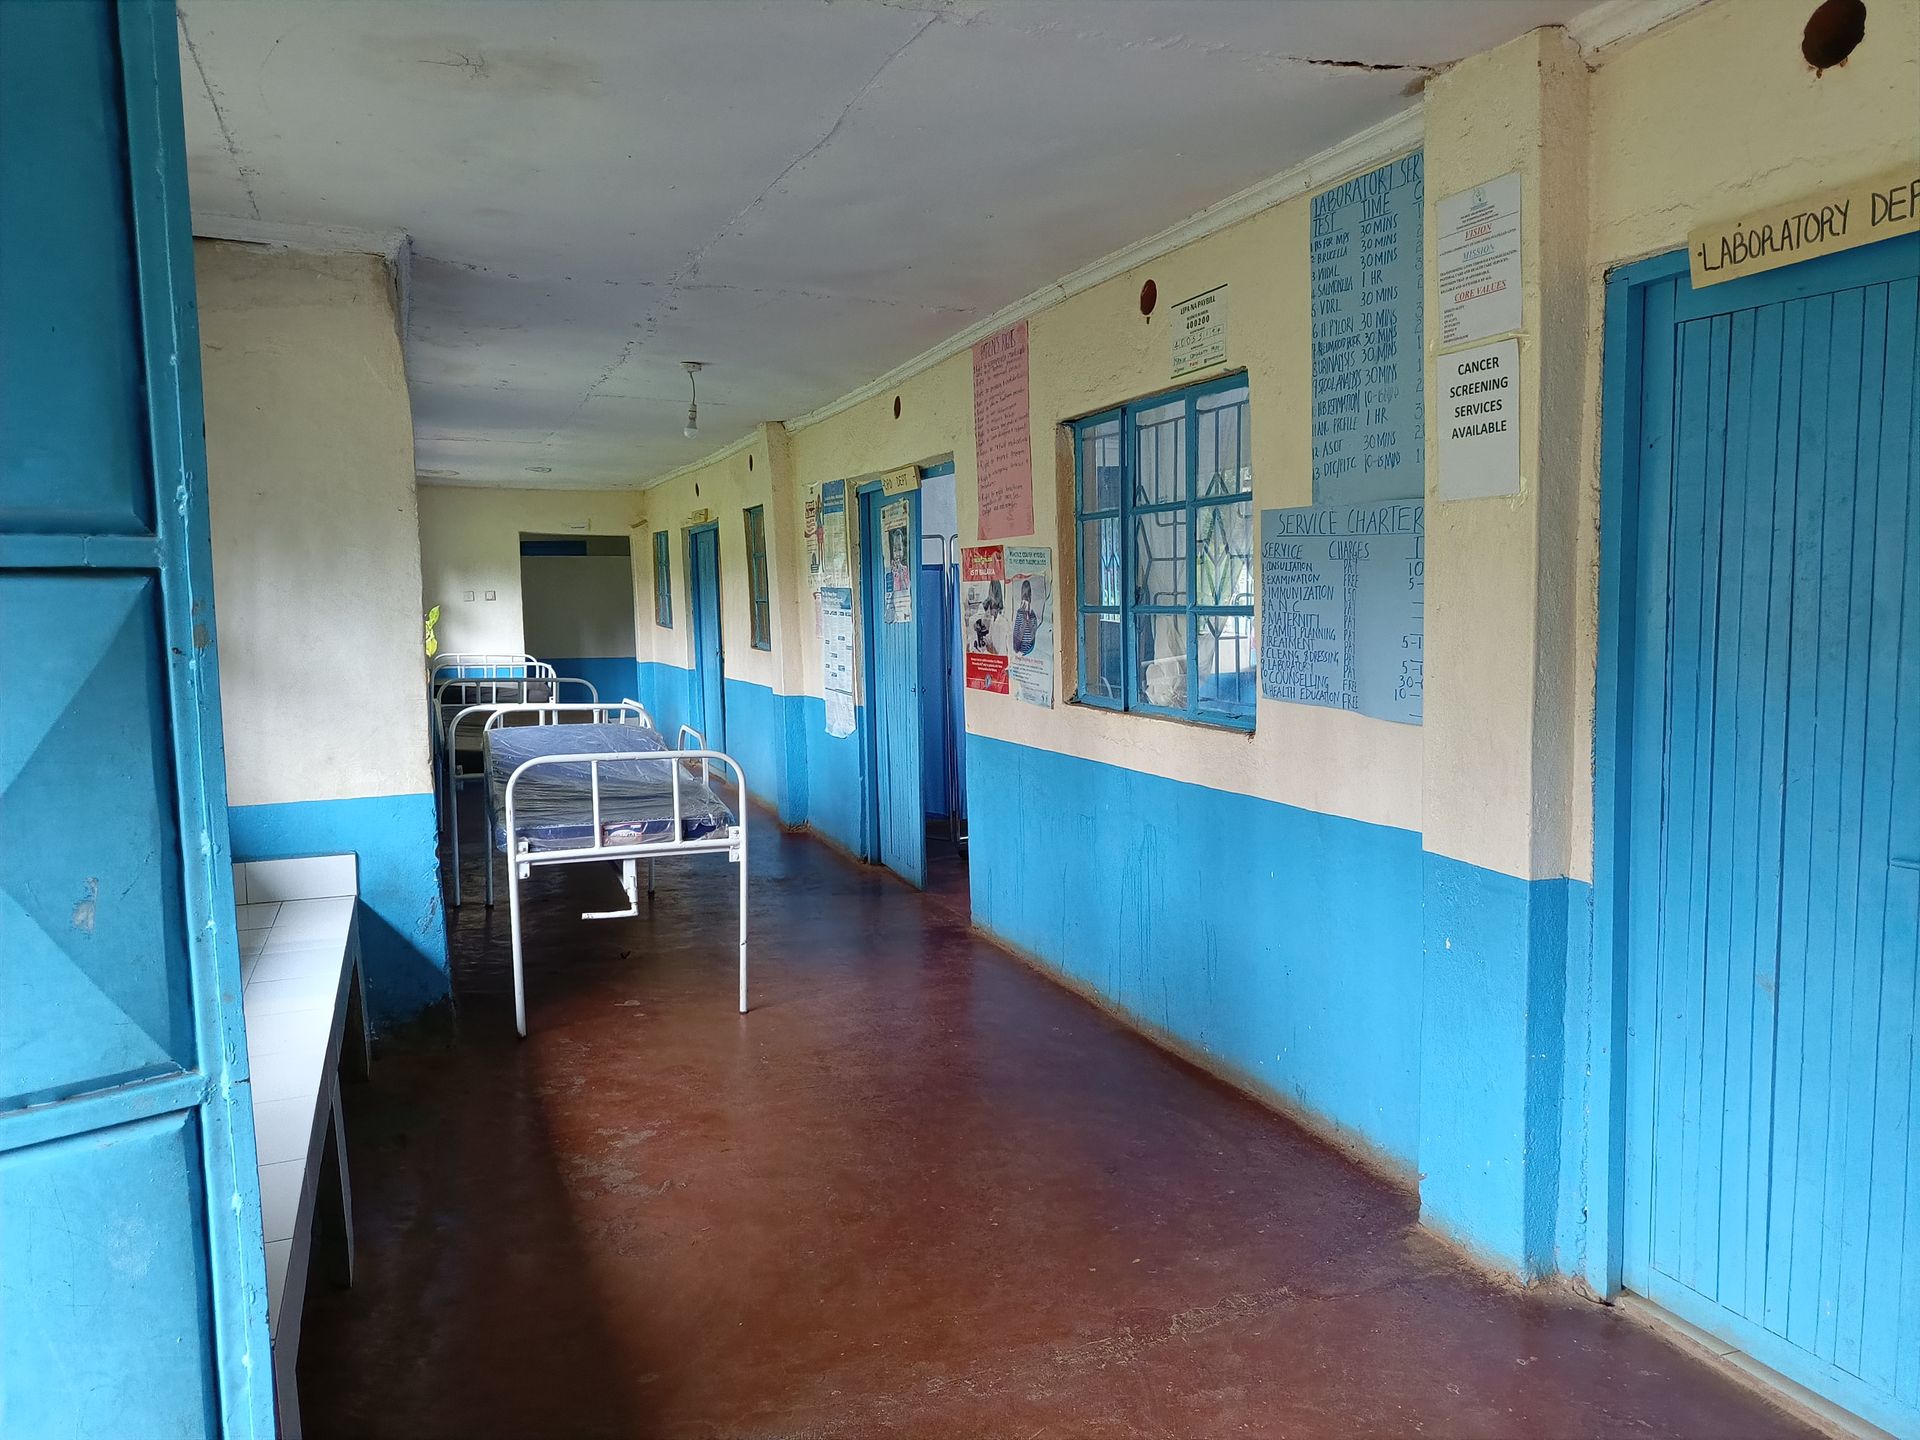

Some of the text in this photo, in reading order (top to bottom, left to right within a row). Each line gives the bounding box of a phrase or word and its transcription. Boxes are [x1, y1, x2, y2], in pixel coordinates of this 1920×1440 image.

[1314, 212, 1336, 237] TEST
[1361, 192, 1390, 220] TIME
[1360, 222, 1371, 238] 30
[1373, 214, 1398, 235] MINS
[1465, 223, 1493, 239] VISION
[1702, 199, 1849, 271] LABORATORY
[1360, 239, 1372, 253] 30
[1375, 233, 1397, 248] MINS
[1463, 243, 1495, 260] MISSION
[1360, 253, 1373, 270] 30
[1375, 247, 1398, 266] MINS
[1371, 269, 1382, 285] HR
[1454, 280, 1506, 301] CORE VALUES
[1320, 298, 1342, 316] VDRL
[1360, 291, 1373, 307] 30
[1376, 286, 1398, 303] MINS
[1329, 317, 1354, 337] PYLORI
[1360, 312, 1372, 330] 30
[1376, 308, 1397, 328] MINS
[1363, 331, 1375, 347] 30
[1377, 325, 1397, 344] MINS
[1362, 347, 1375, 363] 30
[1376, 341, 1397, 361] MINS
[1364, 366, 1377, 386] 30
[1378, 363, 1398, 384] MINS
[1458, 356, 1500, 376] CANCER
[1449, 376, 1508, 399] SCREENING
[1375, 407, 1388, 425] HR
[1454, 399, 1503, 418] SERVICES
[1451, 420, 1507, 440] AVAILABLE
[1363, 434, 1375, 451] 30
[1278, 505, 1424, 535] SERVICE CHARTER
[1262, 542, 1303, 559] SERVICE
[1328, 540, 1370, 559] CHARGES
[1266, 561, 1313, 573] CONSULTATION
[1267, 574, 1320, 585] EXAMINATION
[1343, 574, 1359, 588] FREE
[1268, 585, 1334, 600] IMMUNIZATION
[1268, 612, 1320, 629] MATERNITY
[1266, 635, 1315, 651] TREATMENT
[1300, 626, 1336, 641] PLANNING
[1269, 671, 1329, 689] COUNSELLING
[1269, 685, 1295, 699] HEALTH
[1300, 687, 1341, 705] EDUCATION
[1343, 692, 1358, 710] FREE
